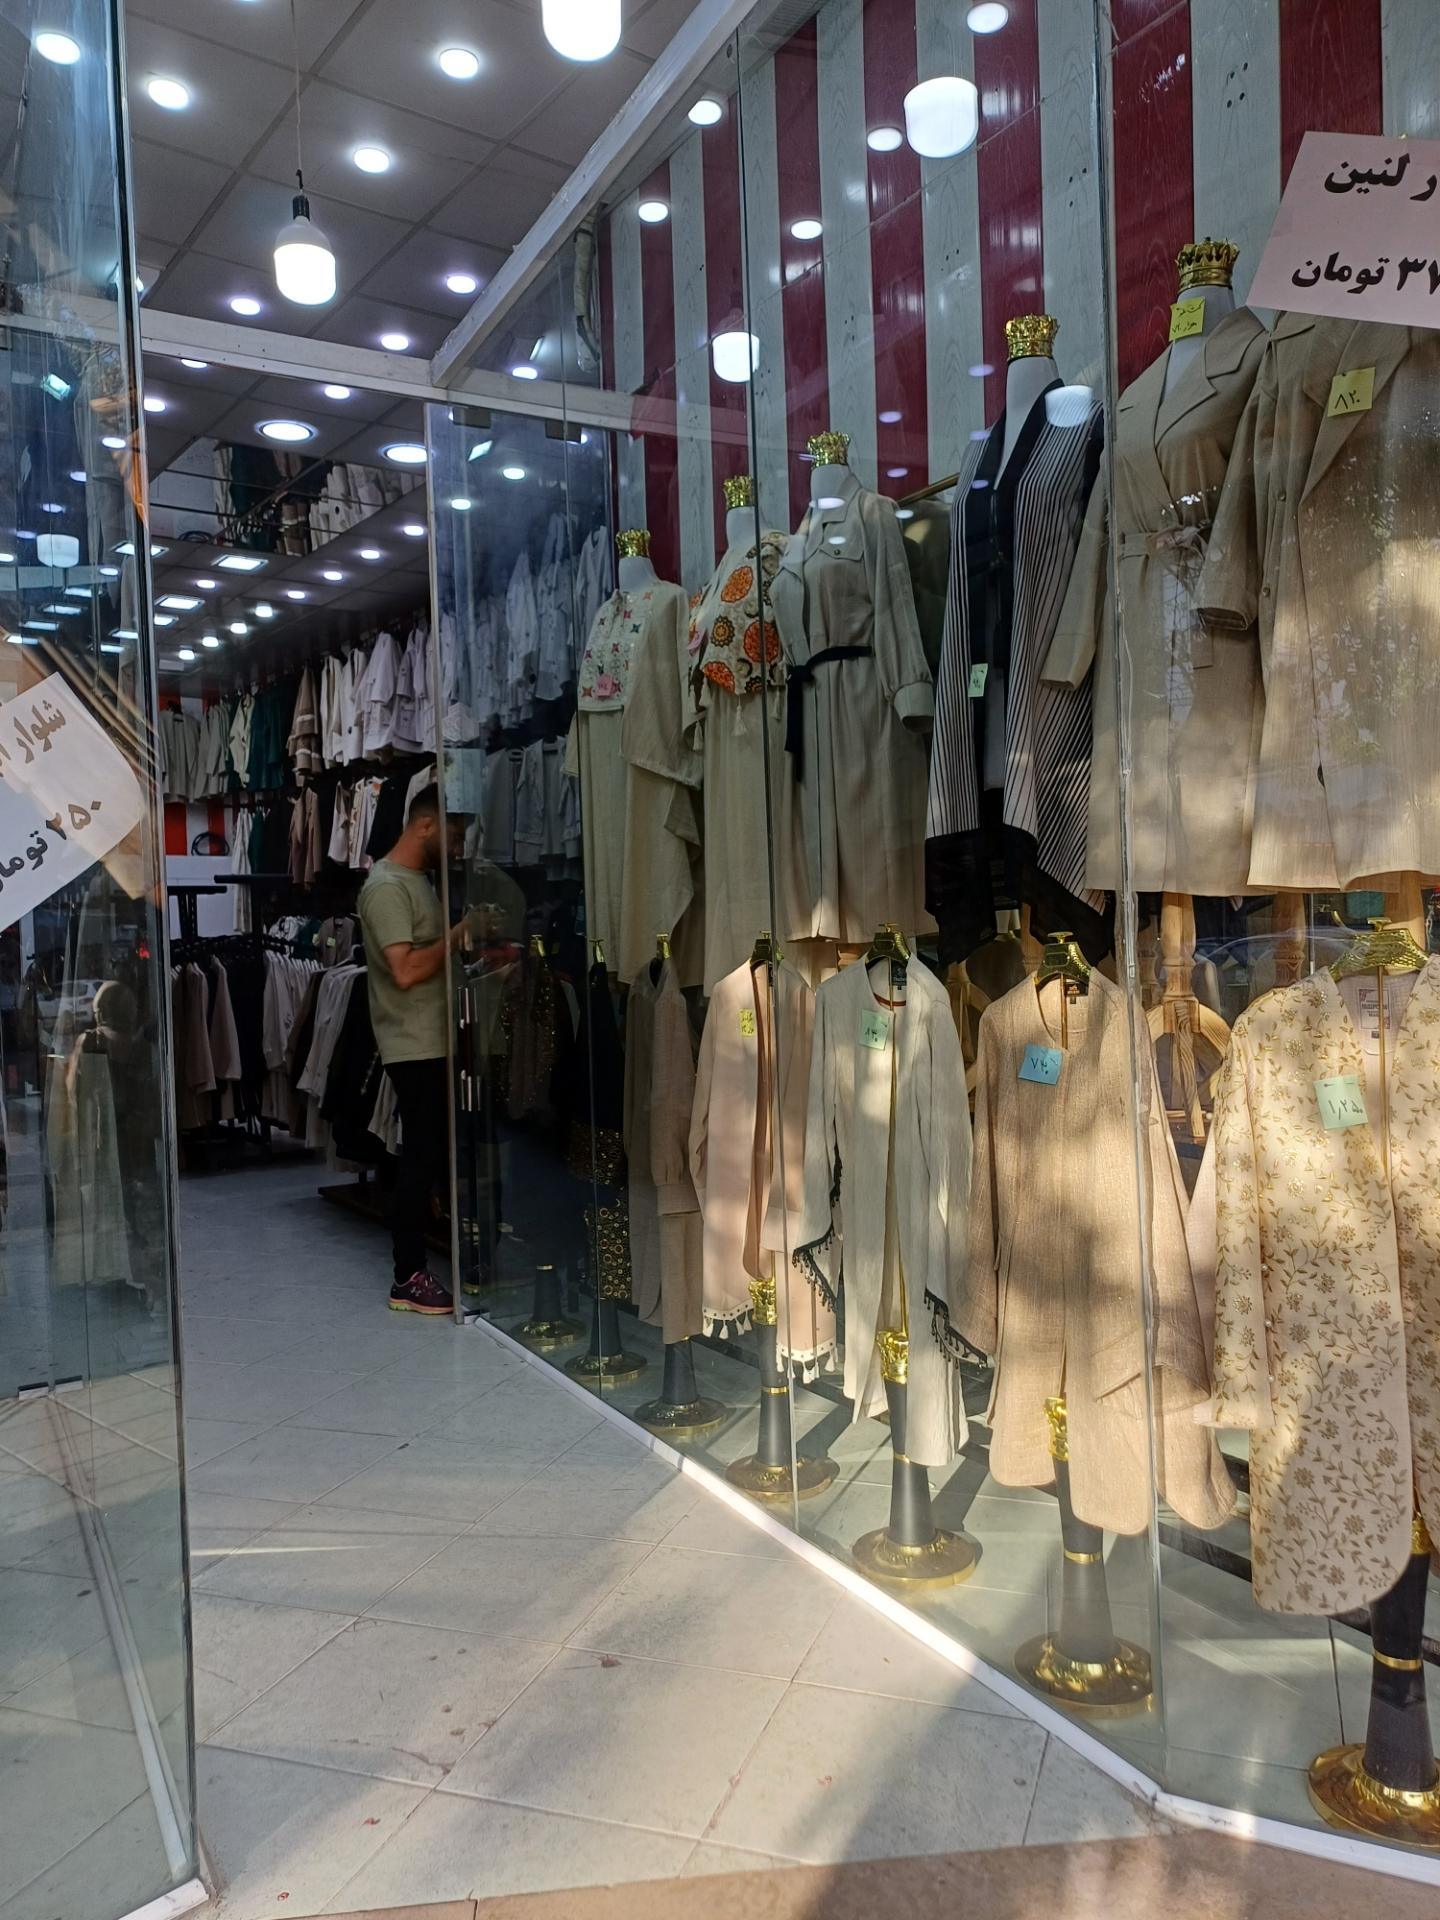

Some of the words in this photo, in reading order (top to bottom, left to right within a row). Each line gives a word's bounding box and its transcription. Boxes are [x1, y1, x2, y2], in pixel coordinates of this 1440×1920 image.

[1324, 152, 1411, 194] لنین
[1291, 251, 1390, 295] تومان
[1334, 389, 1360, 410] ۸۲۰
[13, 699, 66, 765] شلوار
[45, 800, 102, 841] ۲۵۰
[0, 830, 49, 893] توما
